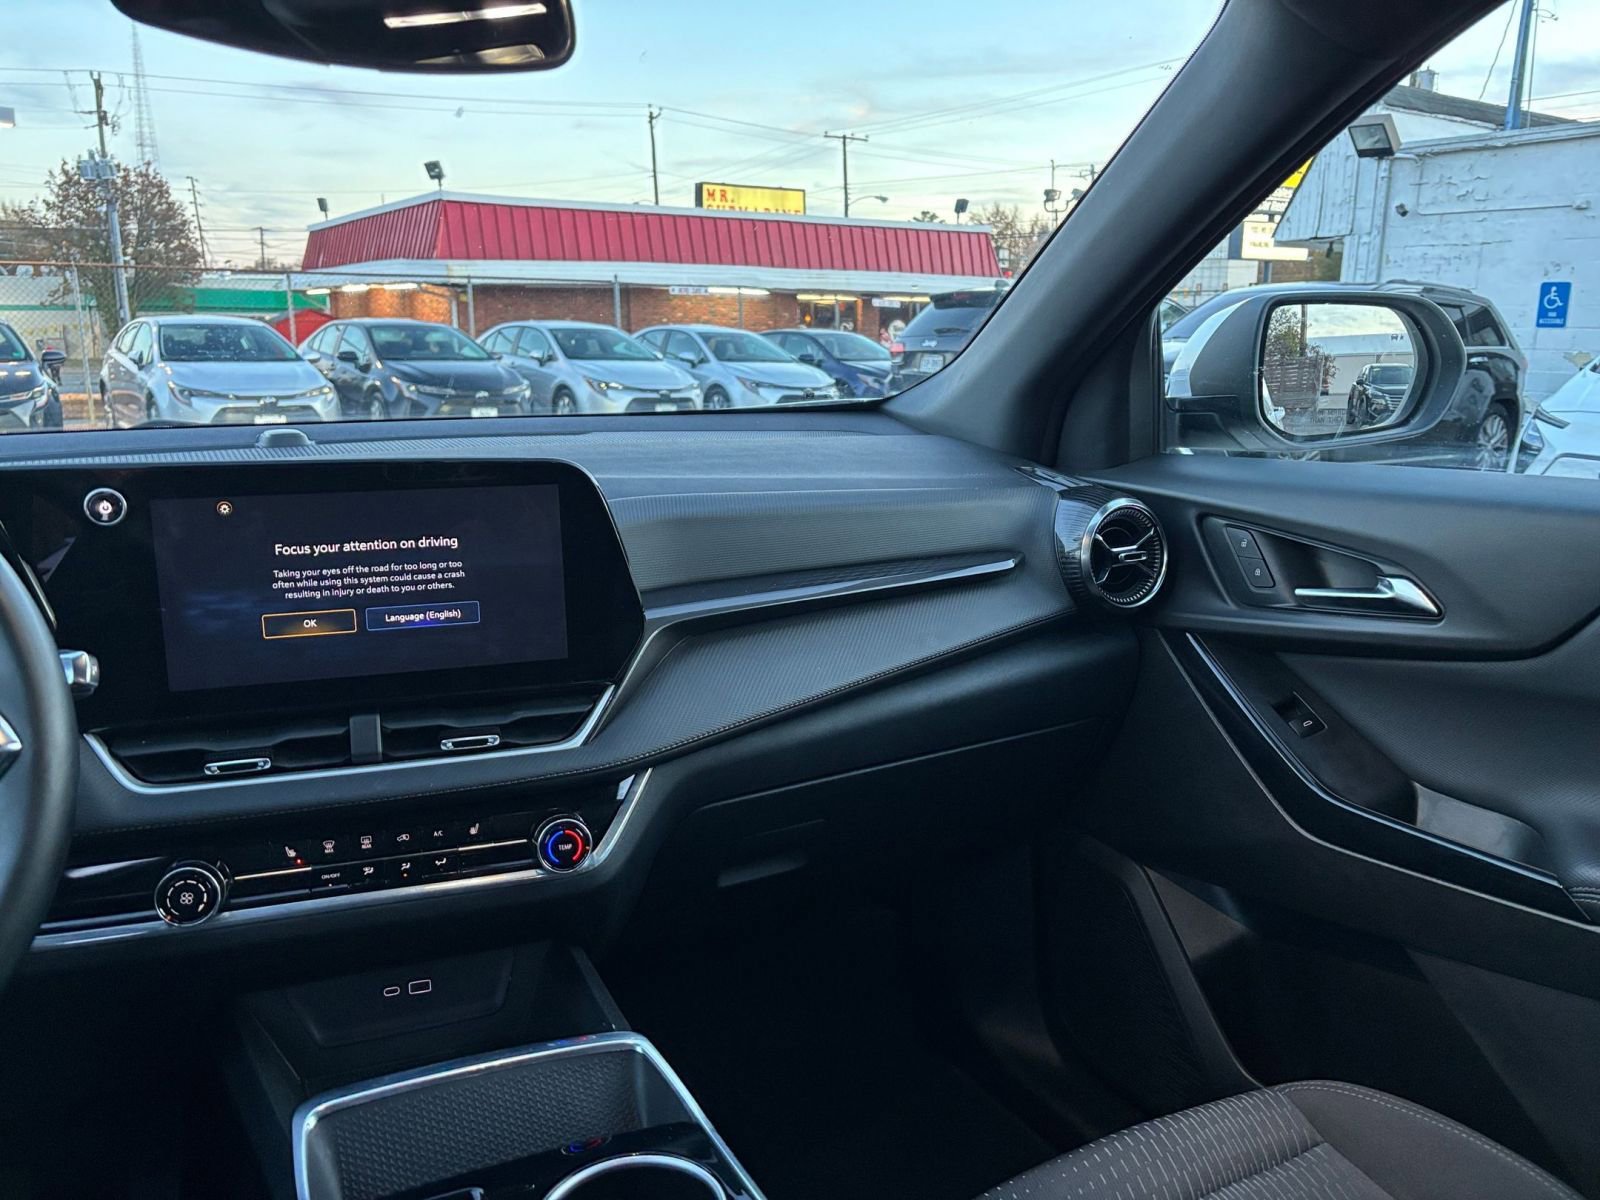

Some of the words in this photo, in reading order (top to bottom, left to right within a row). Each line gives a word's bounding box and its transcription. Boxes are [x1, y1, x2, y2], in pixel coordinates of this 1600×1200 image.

[274, 543, 311, 556] Focus
[313, 543, 341, 556] your
[343, 539, 398, 553] attention
[400, 539, 416, 549] on
[418, 536, 459, 549] driving
[273, 569, 301, 579] Taking
[302, 569, 321, 578] your
[322, 567, 341, 577] eyes
[342, 565, 356, 574] off
[356, 564, 370, 573] the
[371, 563, 390, 572] road
[391, 562, 403, 571] for
[404, 562, 418, 570] too
[419, 561, 438, 571] long
[448, 560, 463, 568] too
[272, 580, 295, 590] often
[297, 578, 319, 588] while
[320, 578, 343, 587] using
[343, 576, 359, 585] this
[360, 575, 389, 586] system
[390, 573, 412, 582] could
[413, 573, 437, 581] cause
[444, 569, 466, 578] crash
[285, 589, 321, 600] resulting
[322, 588, 331, 597] in
[331, 587, 355, 598] injury
[355, 587, 366, 595] or
[366, 584, 390, 594] death
[391, 584, 400, 592] to
[400, 584, 416, 594] you
[416, 583, 427, 591] or
[427, 580, 456, 590] others.
[303, 618, 318, 629] OK
[385, 611, 425, 624] Language
[426, 608, 462, 621] (English)
[433, 829, 444, 838] A/C
[558, 843, 573, 851] TEMP
[321, 872, 341, 880] ON/OFF
